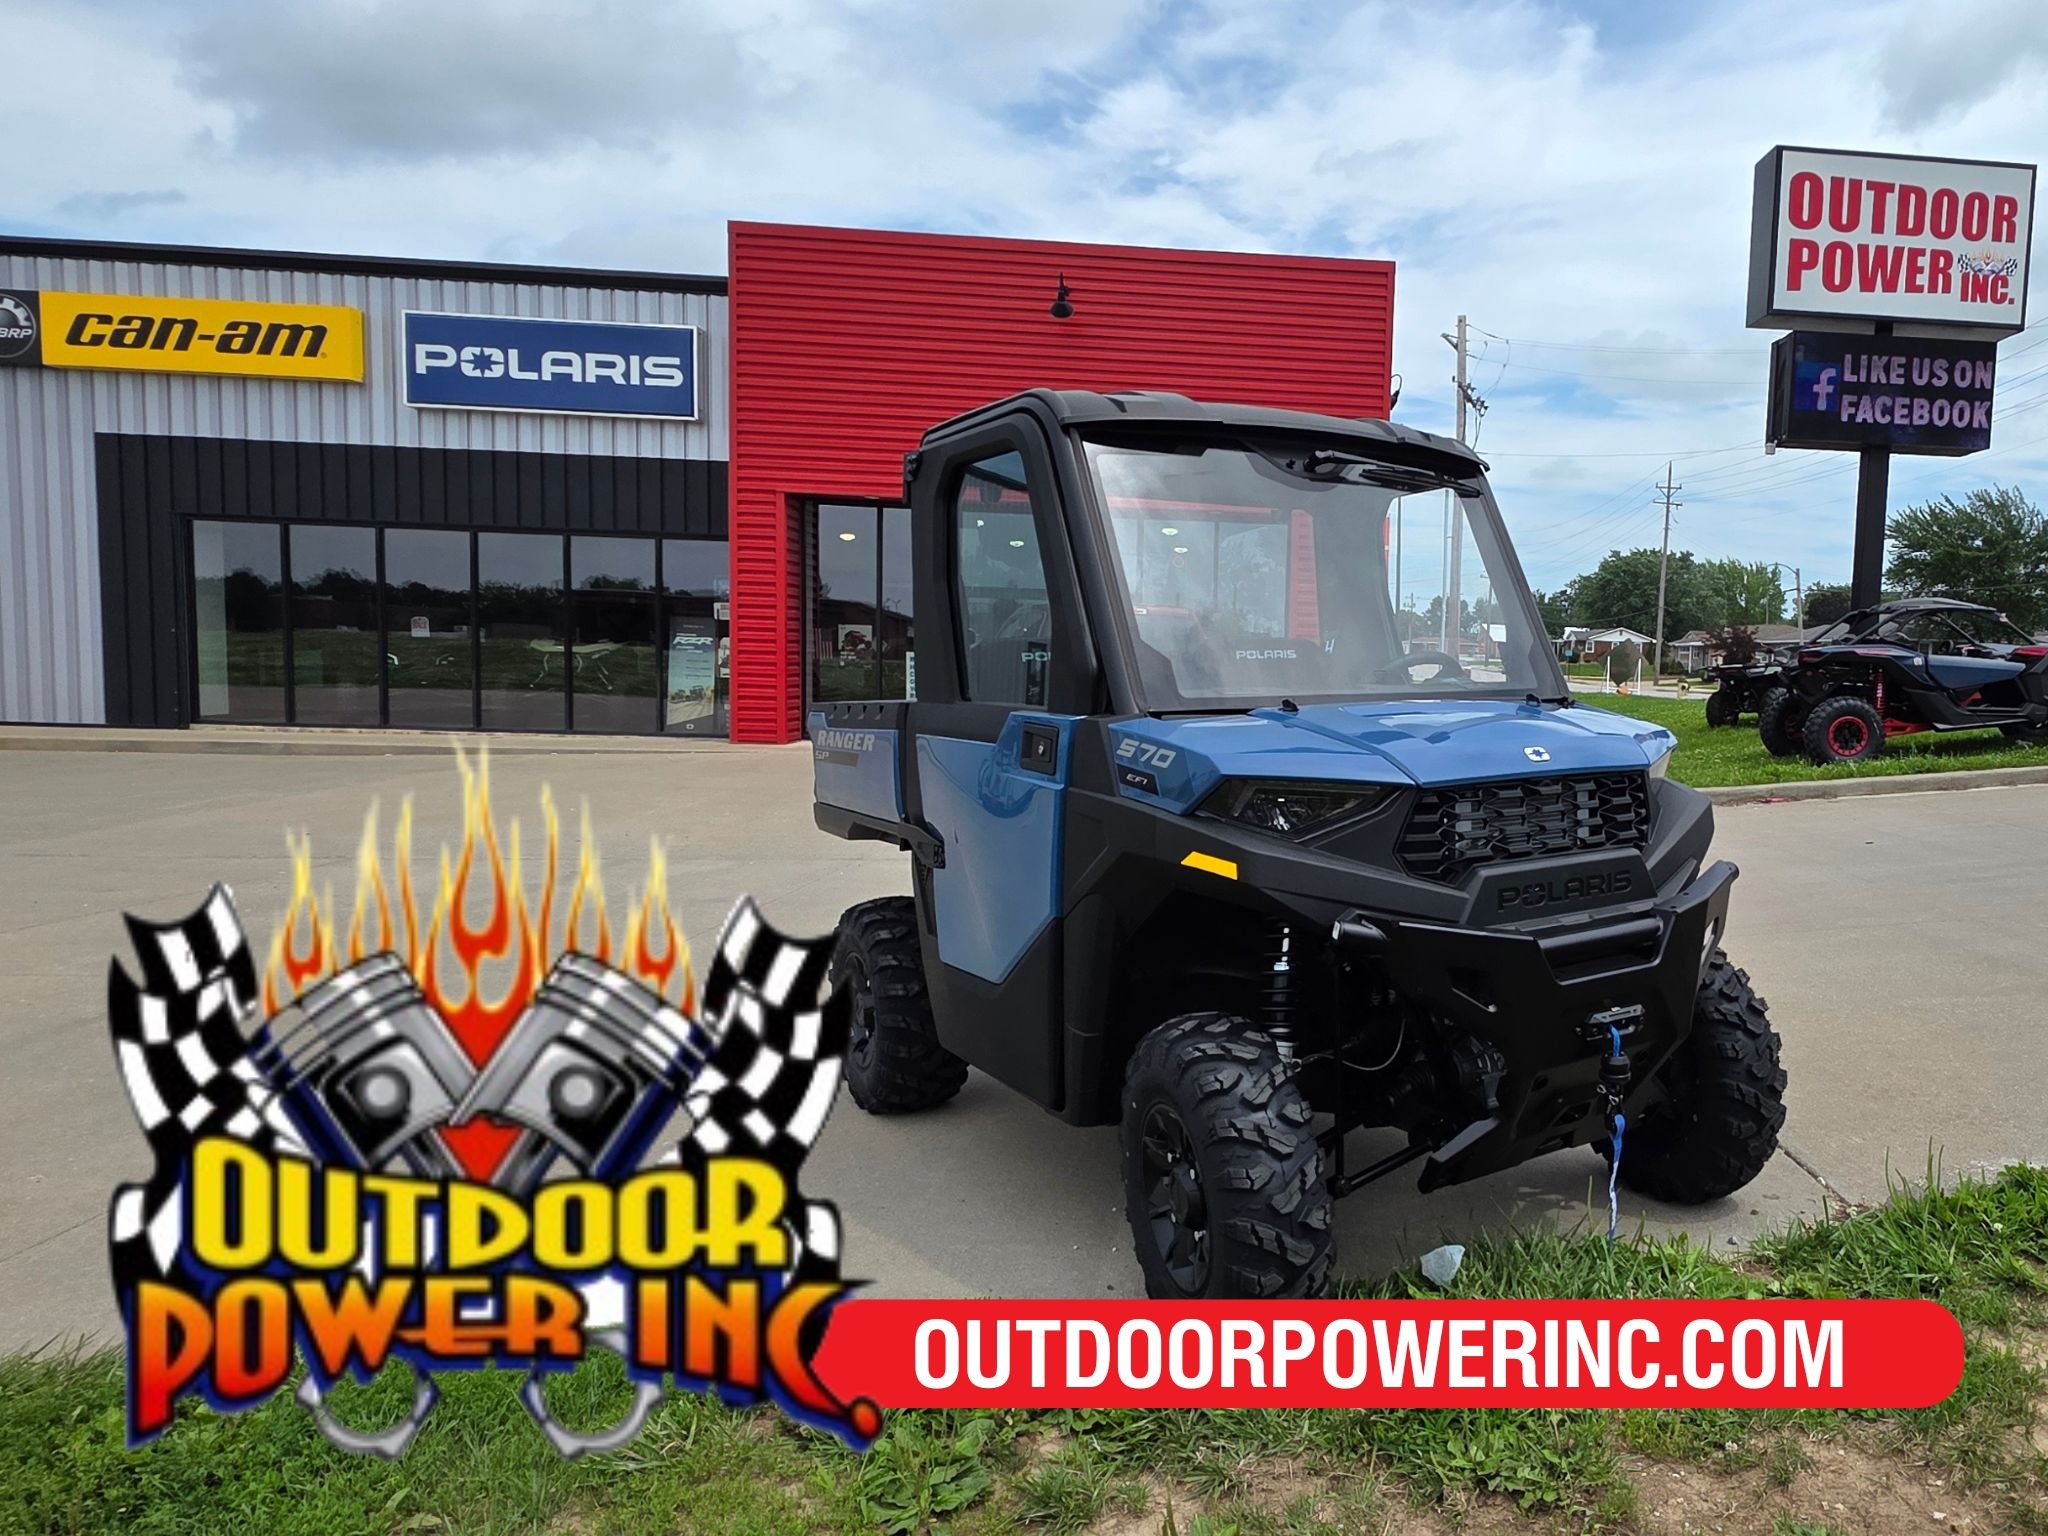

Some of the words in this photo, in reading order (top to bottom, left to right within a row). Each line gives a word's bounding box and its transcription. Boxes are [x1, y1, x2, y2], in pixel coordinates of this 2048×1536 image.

[1788, 171, 2019, 243] OUTDOOR
[1786, 238, 1954, 294] POWER
[1960, 272, 2015, 305] INC.
[65, 313, 328, 358] can-am
[415, 343, 684, 388] POLARIS
[1843, 354, 1906, 385] LIKE
[1912, 357, 1950, 387] US
[1954, 360, 1993, 389] ON
[1840, 394, 1991, 429] FACEBOOK
[1235, 649, 1297, 660] POLARIS
[817, 730, 875, 751] RANGER
[1116, 738, 1177, 769] 570
[1497, 870, 1632, 912] POLARIS
